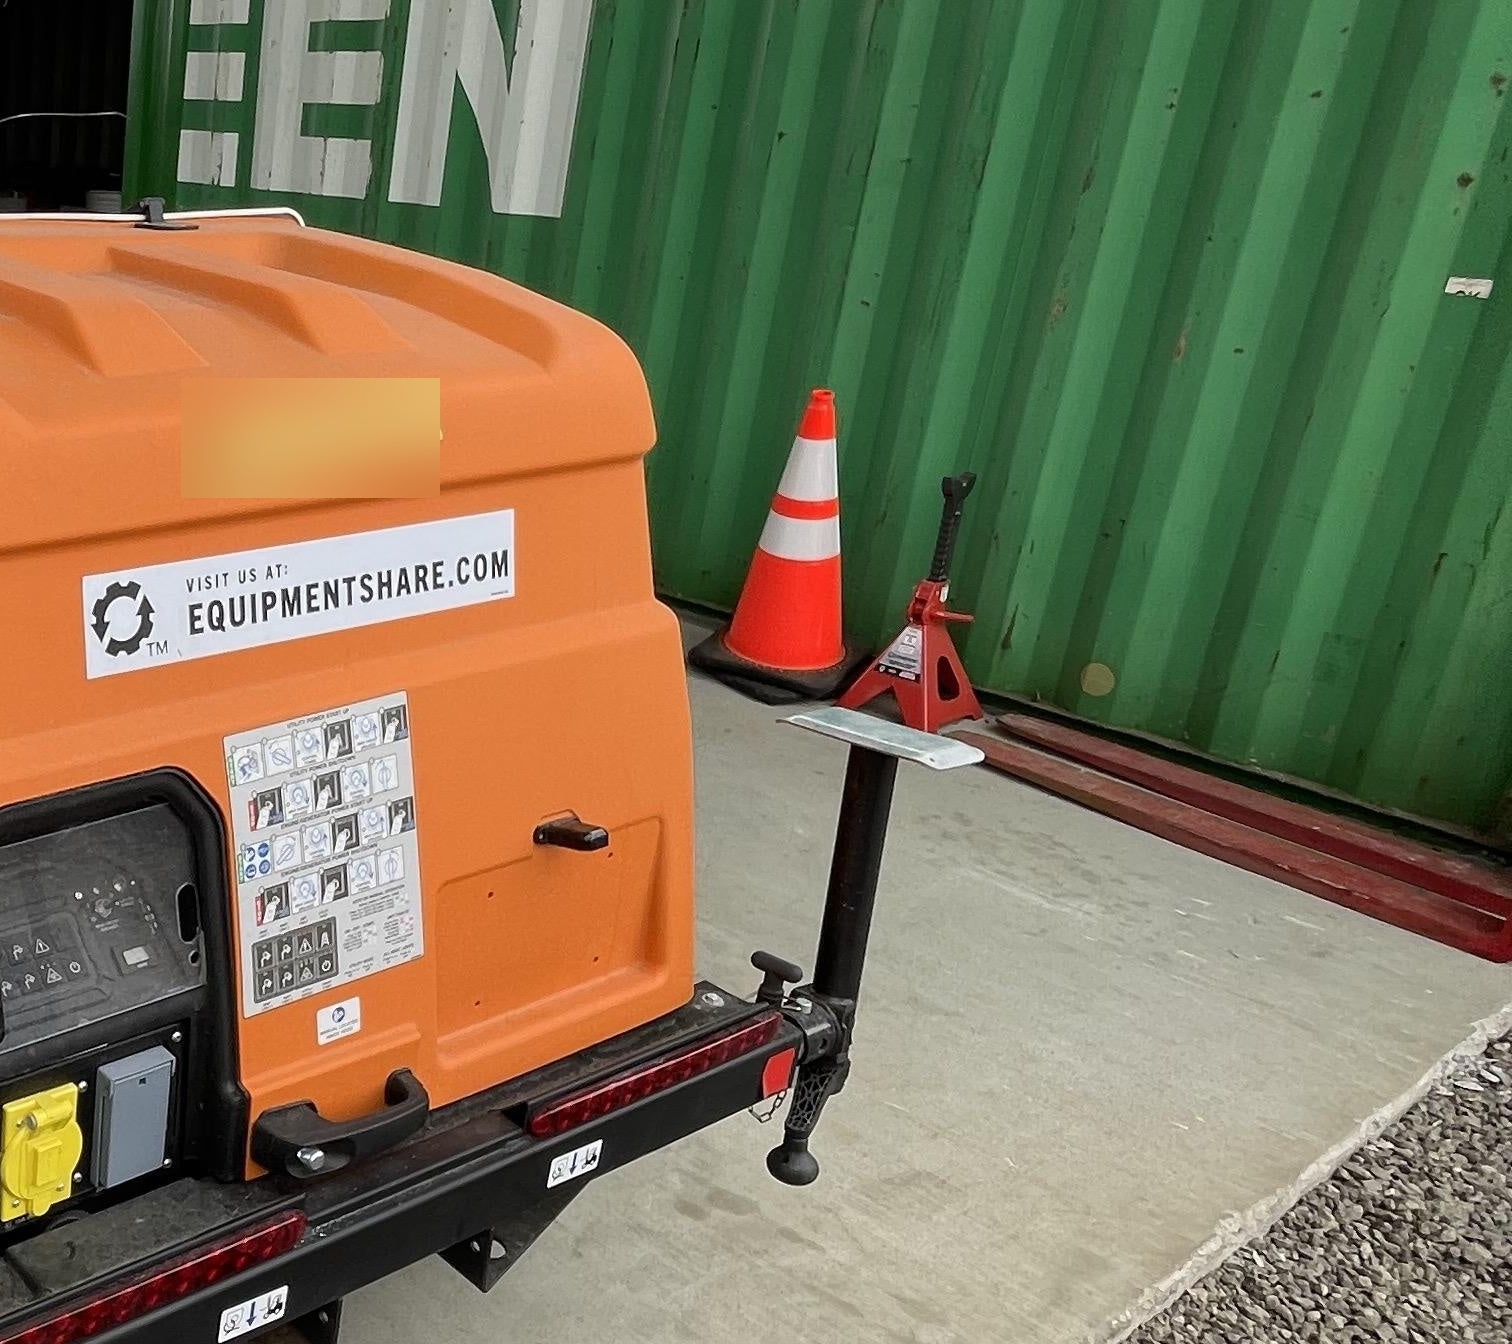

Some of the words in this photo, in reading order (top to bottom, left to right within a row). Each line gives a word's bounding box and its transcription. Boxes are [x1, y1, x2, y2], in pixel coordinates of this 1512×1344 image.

[186, 571, 229, 593] VISIT
[238, 567, 257, 585] US
[265, 563, 289, 580] AT:
[189, 549, 509, 635] EQUIPMENTSHARE.COM
[146, 639, 168, 657] TM
